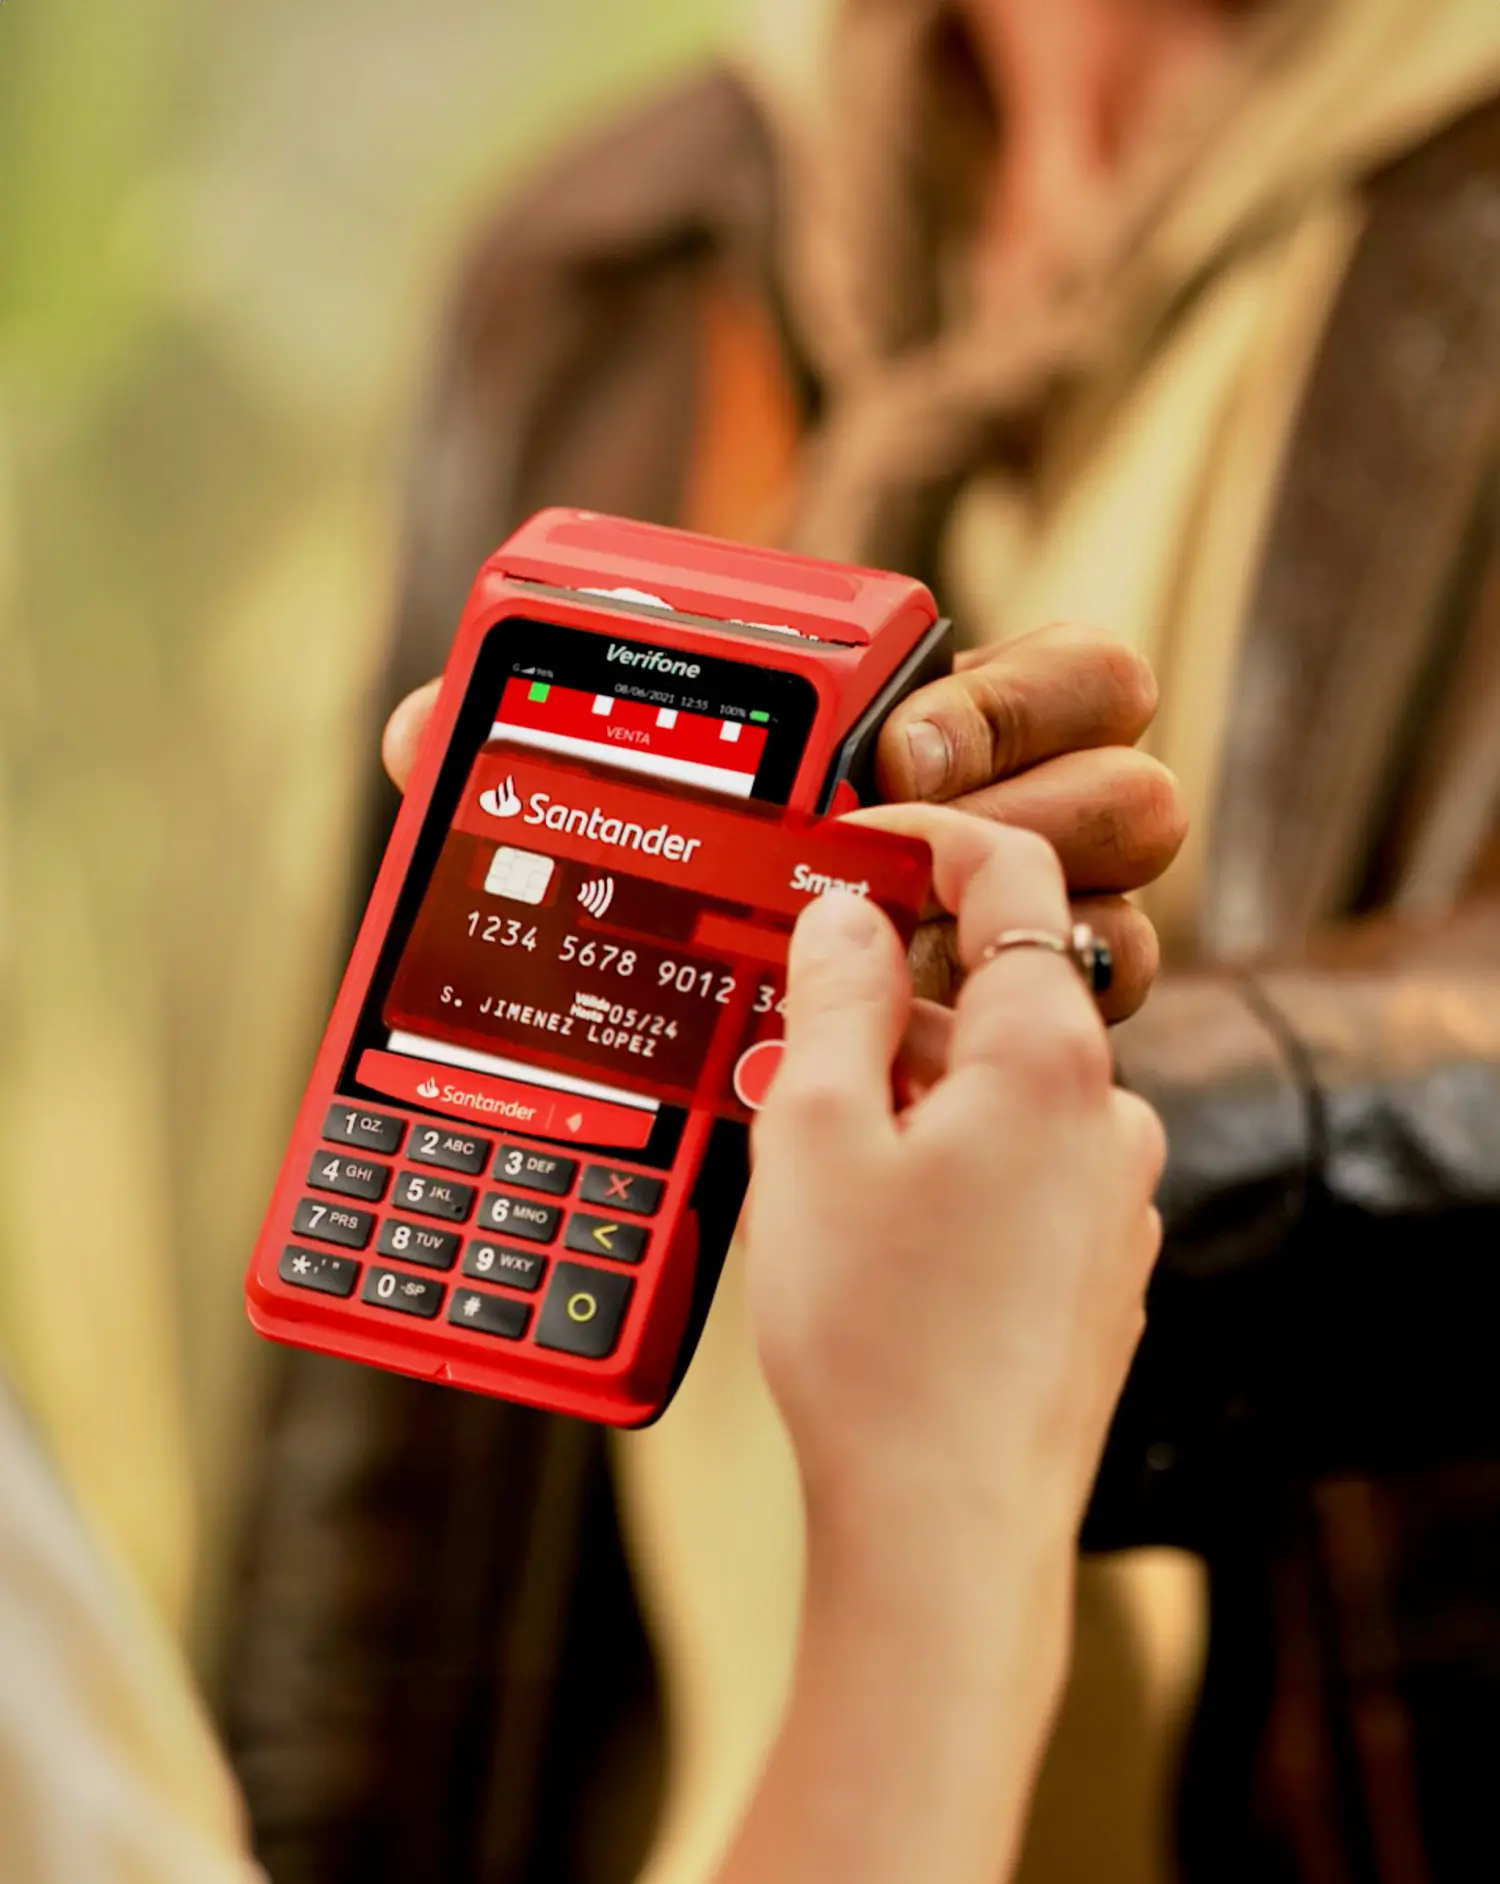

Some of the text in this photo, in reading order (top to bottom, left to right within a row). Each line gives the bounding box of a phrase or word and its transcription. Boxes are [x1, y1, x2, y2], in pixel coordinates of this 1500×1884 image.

[606, 643, 701, 679] Verifone
[614, 683, 675, 704] 08/06/2021
[720, 704, 747, 718] 100%
[606, 726, 650, 745] VENTA
[523, 793, 701, 863] Santander
[467, 911, 538, 952] 1234
[558, 935, 637, 977] 5678
[657, 960, 736, 1004] 9012
[440, 986, 463, 1007] S.
[479, 997, 575, 1035] JIMENEZ
[587, 1024, 657, 1058] LOPEZ
[608, 1004, 678, 1039] 05/24
[441, 1085, 537, 1122] Santander
[345, 1113, 357, 1134] 1
[420, 1131, 475, 1155] 2 ABC
[322, 1159, 373, 1182] 4 GHI
[504, 1151, 556, 1175] 3 DEF
[406, 1178, 426, 1201] 5
[308, 1205, 359, 1229] 7 PRS
[491, 1199, 548, 1224] 6 MNO
[391, 1226, 443, 1249] 8 TUV
[475, 1248, 535, 1272] 9 WXY
[377, 1274, 396, 1298] 0
